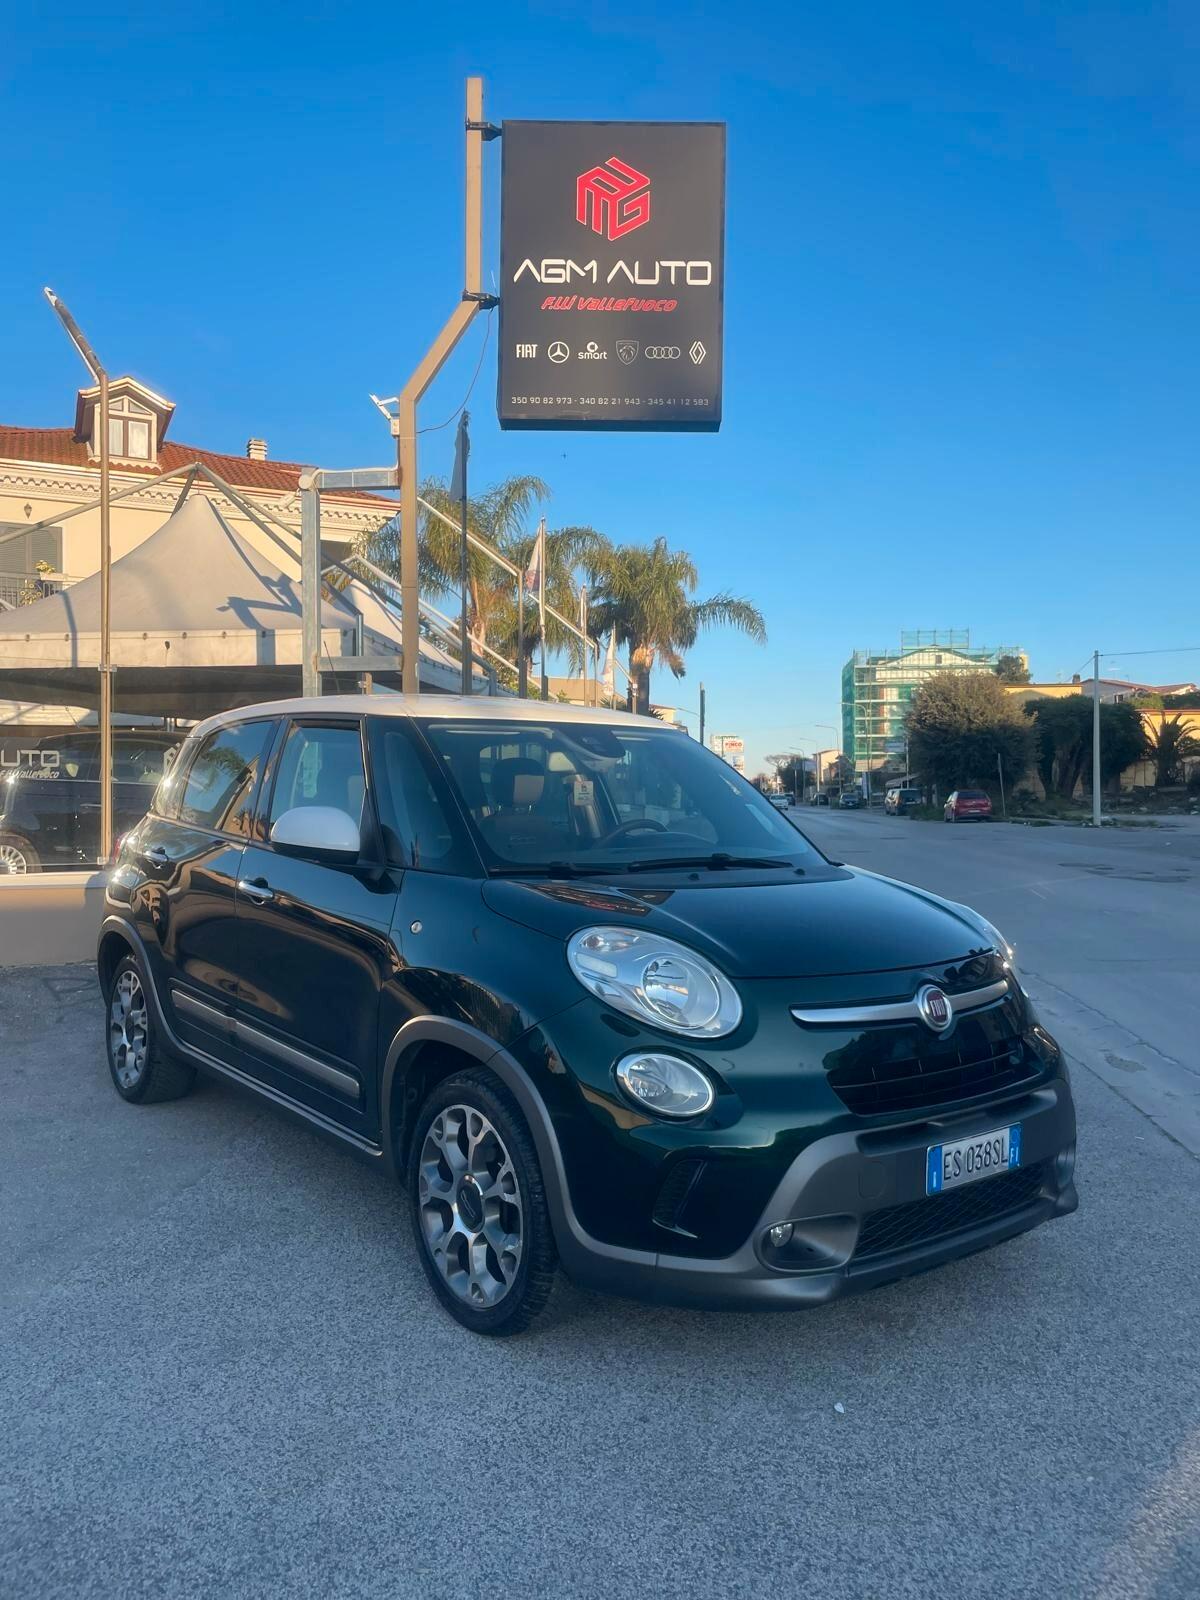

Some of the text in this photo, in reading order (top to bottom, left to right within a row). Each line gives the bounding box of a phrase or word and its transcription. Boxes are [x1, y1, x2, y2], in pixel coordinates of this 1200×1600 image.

[513, 258, 712, 286] AGM AUTO
[516, 343, 538, 358] FIAT
[577, 348, 608, 360] smart
[511, 396, 528, 404] 350
[529, 396, 541, 404] 90
[556, 397, 572, 405] 973
[579, 397, 596, 405] 340
[598, 397, 609, 405] 82
[681, 398, 690, 406] 12
[943, 1150, 962, 1181] ES
